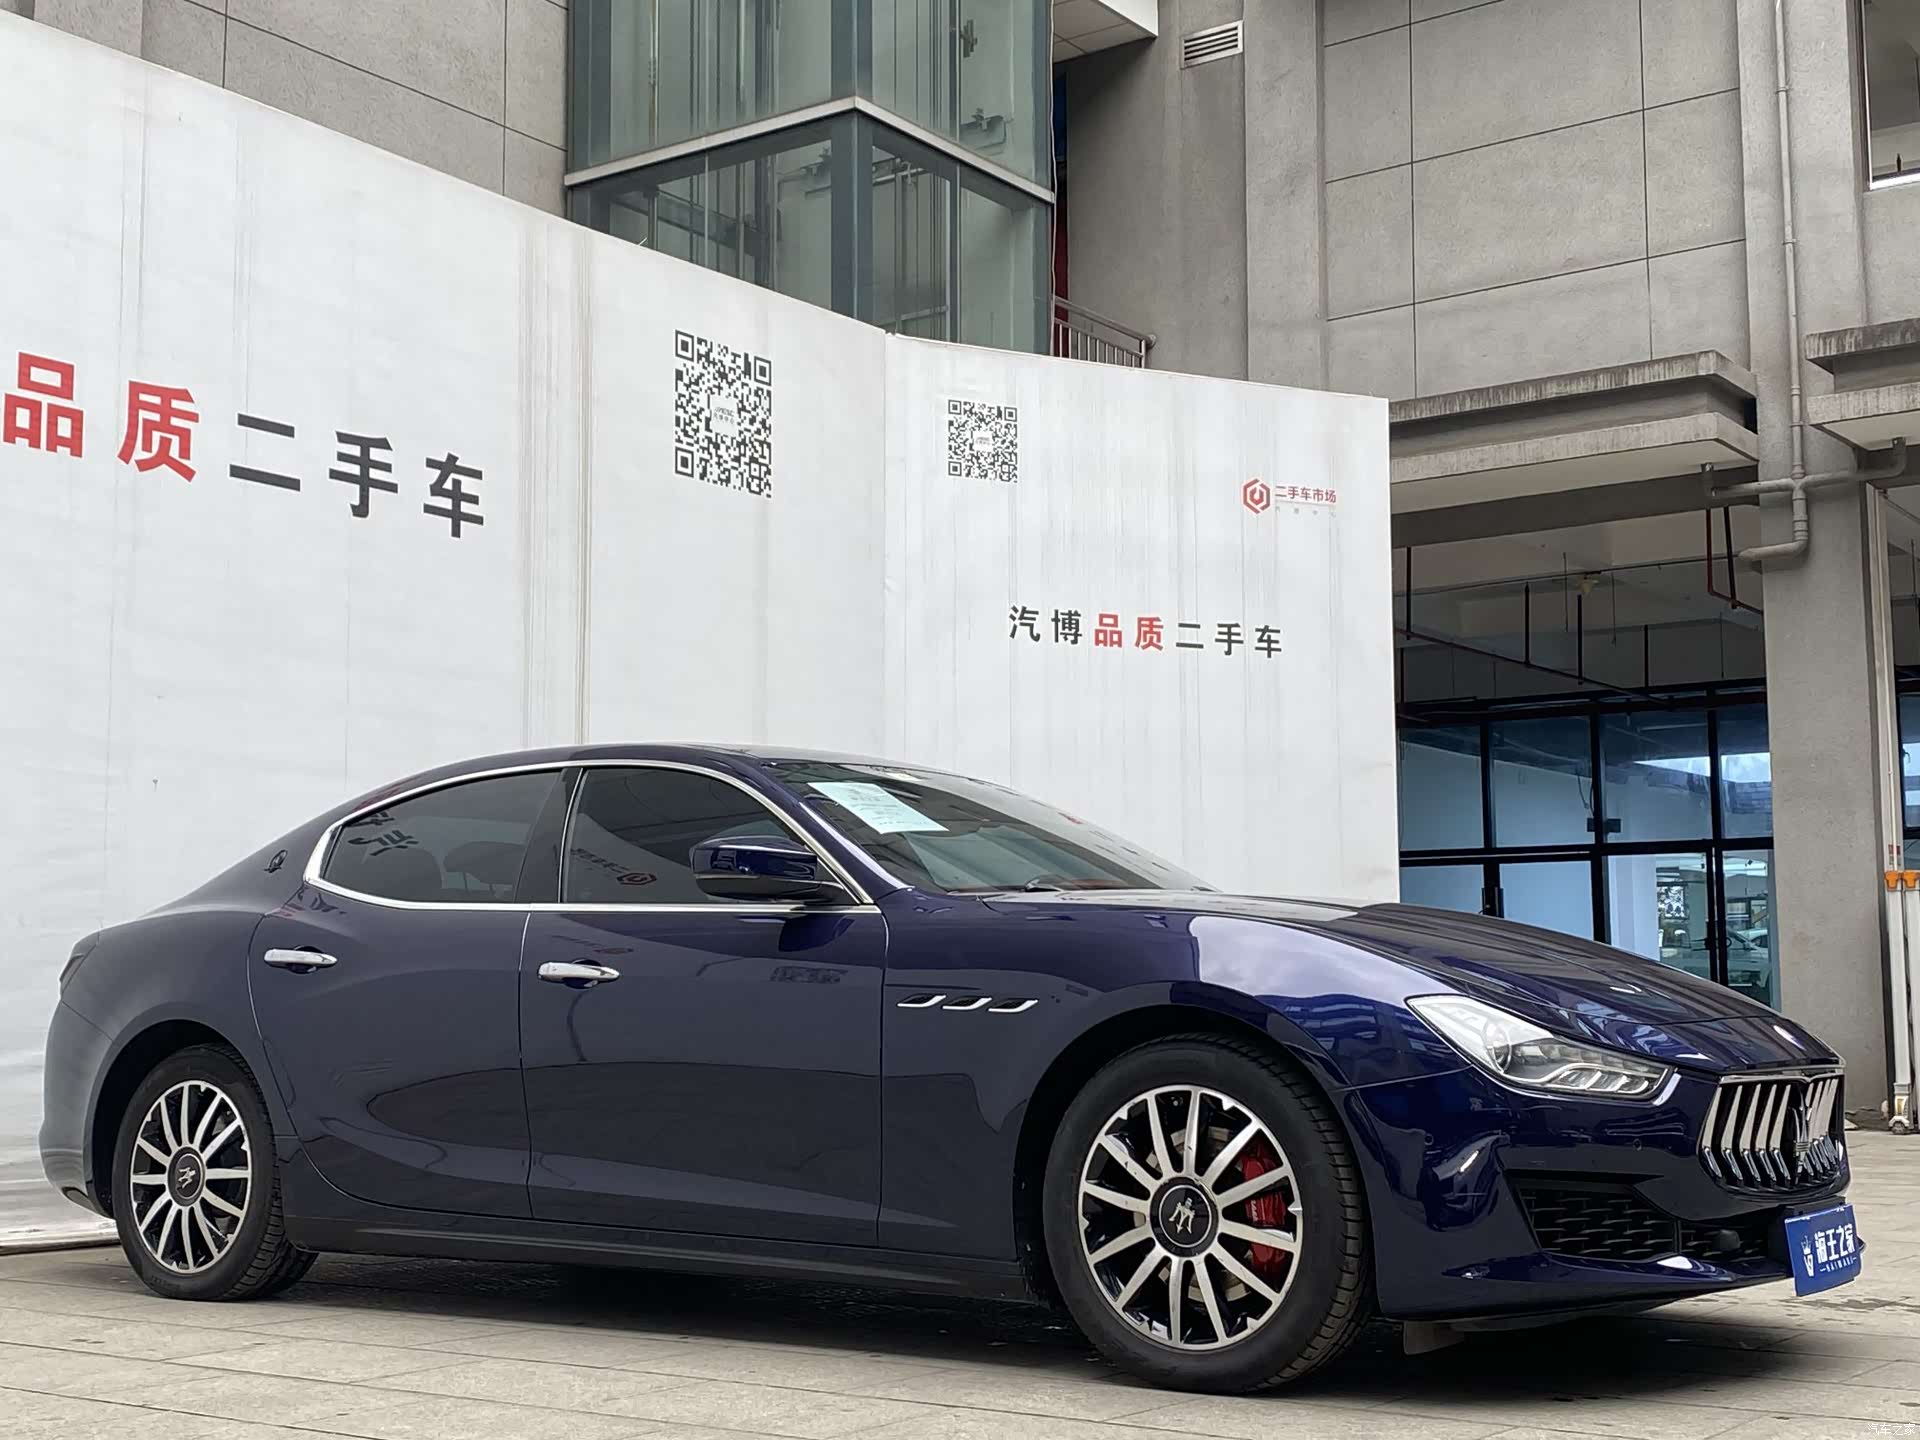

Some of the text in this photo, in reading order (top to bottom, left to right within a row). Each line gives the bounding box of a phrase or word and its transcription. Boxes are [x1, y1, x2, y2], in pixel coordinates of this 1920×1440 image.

[3, 352, 485, 539] 品质二手车
[1275, 485, 1337, 503] 二手车市场
[1008, 605, 1283, 659] 汽博品质二手车
